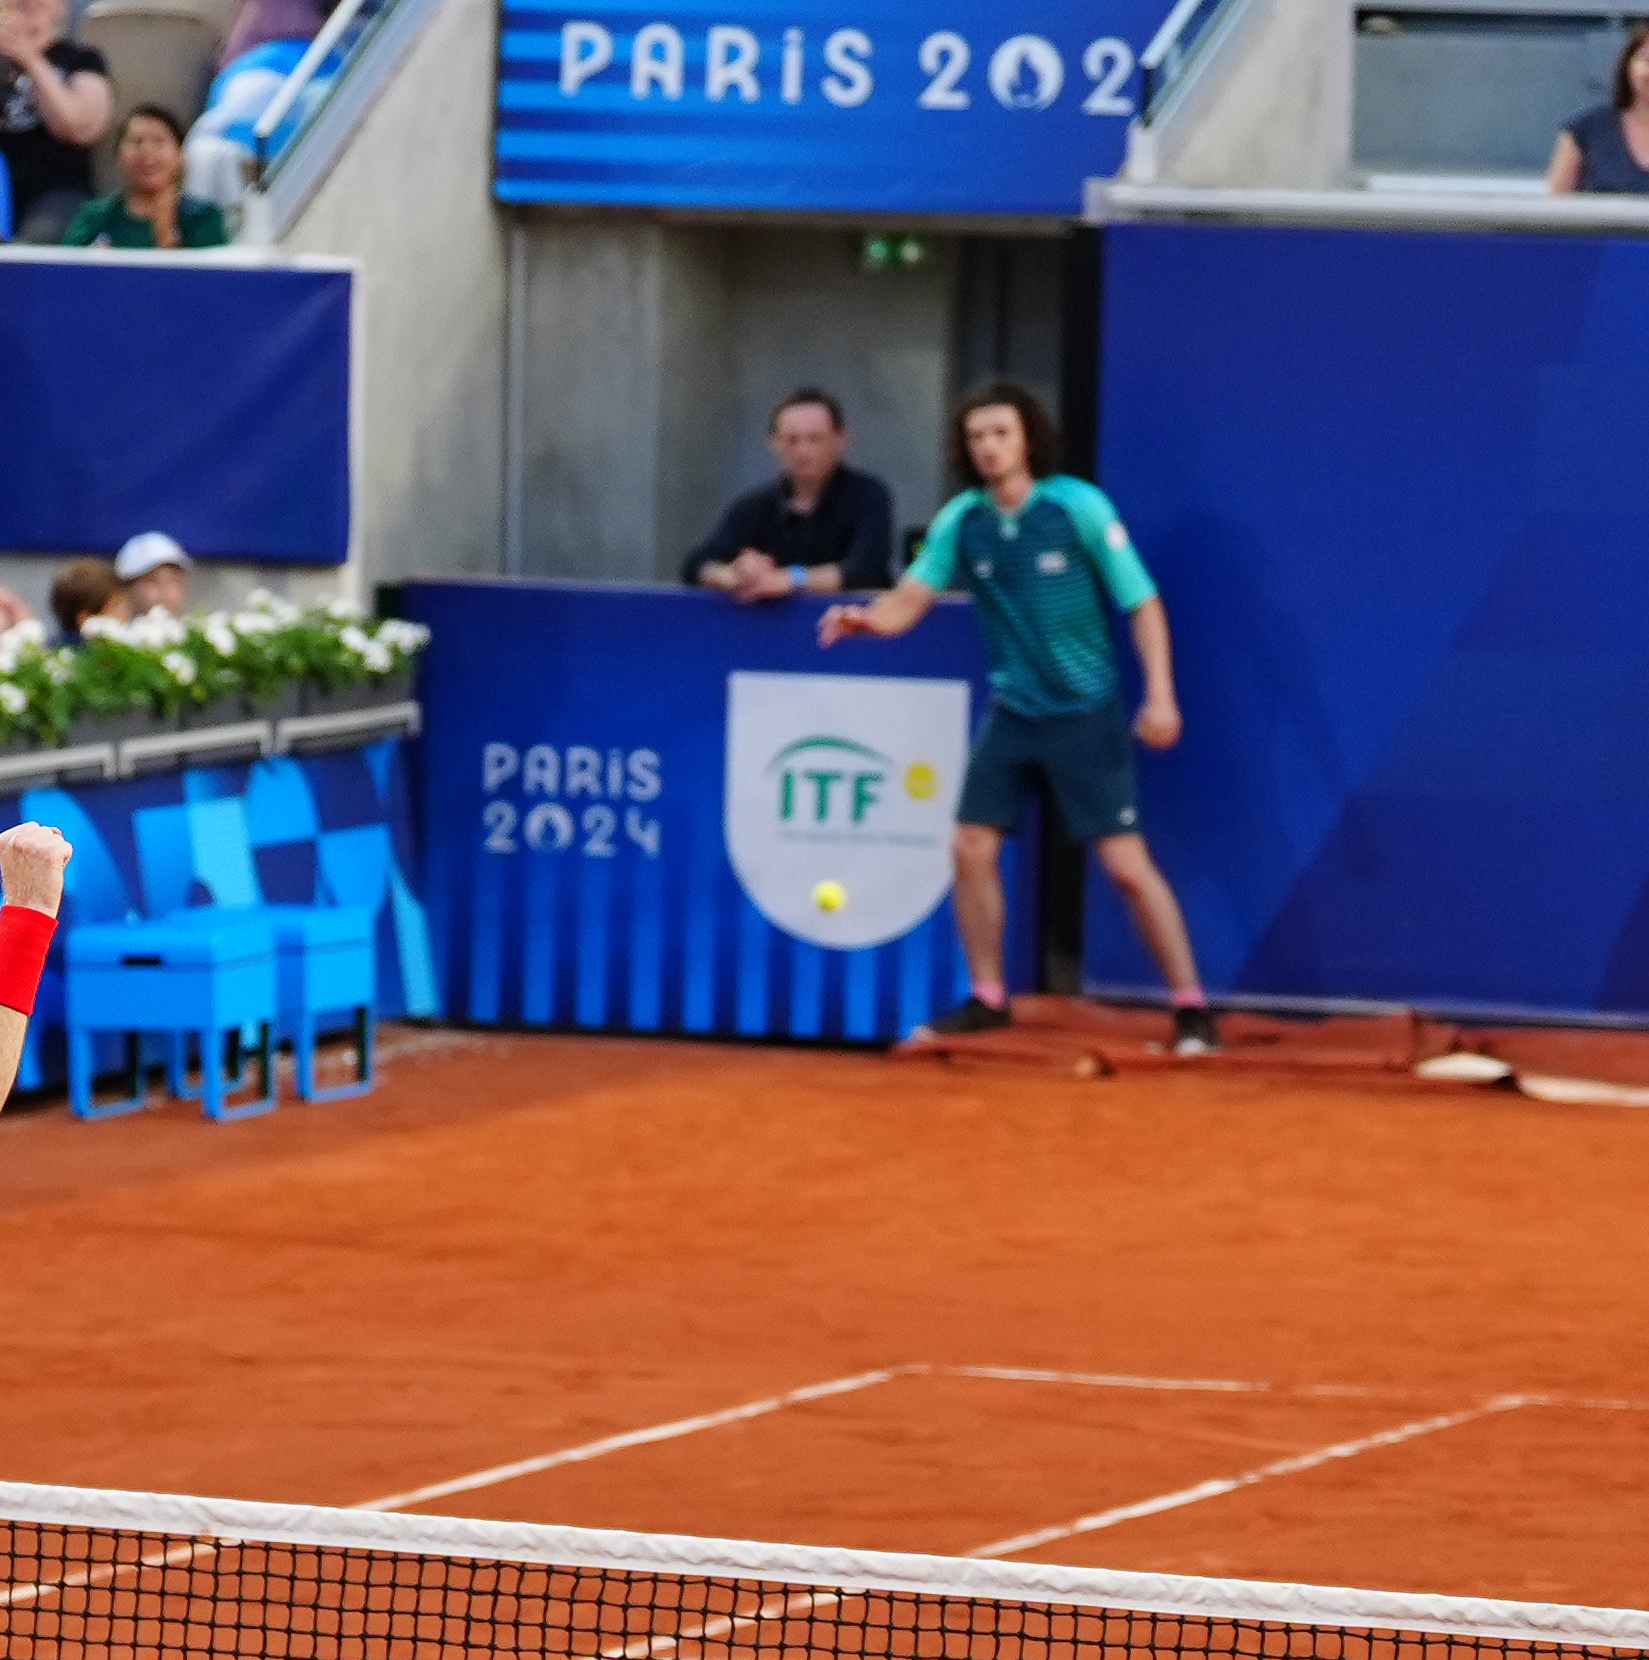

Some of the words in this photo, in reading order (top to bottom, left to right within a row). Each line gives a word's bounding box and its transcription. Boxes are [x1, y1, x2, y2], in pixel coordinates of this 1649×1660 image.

[918, 31, 1135, 116] 202
[780, 769, 885, 823] ITF
[482, 801, 663, 858] 2024
